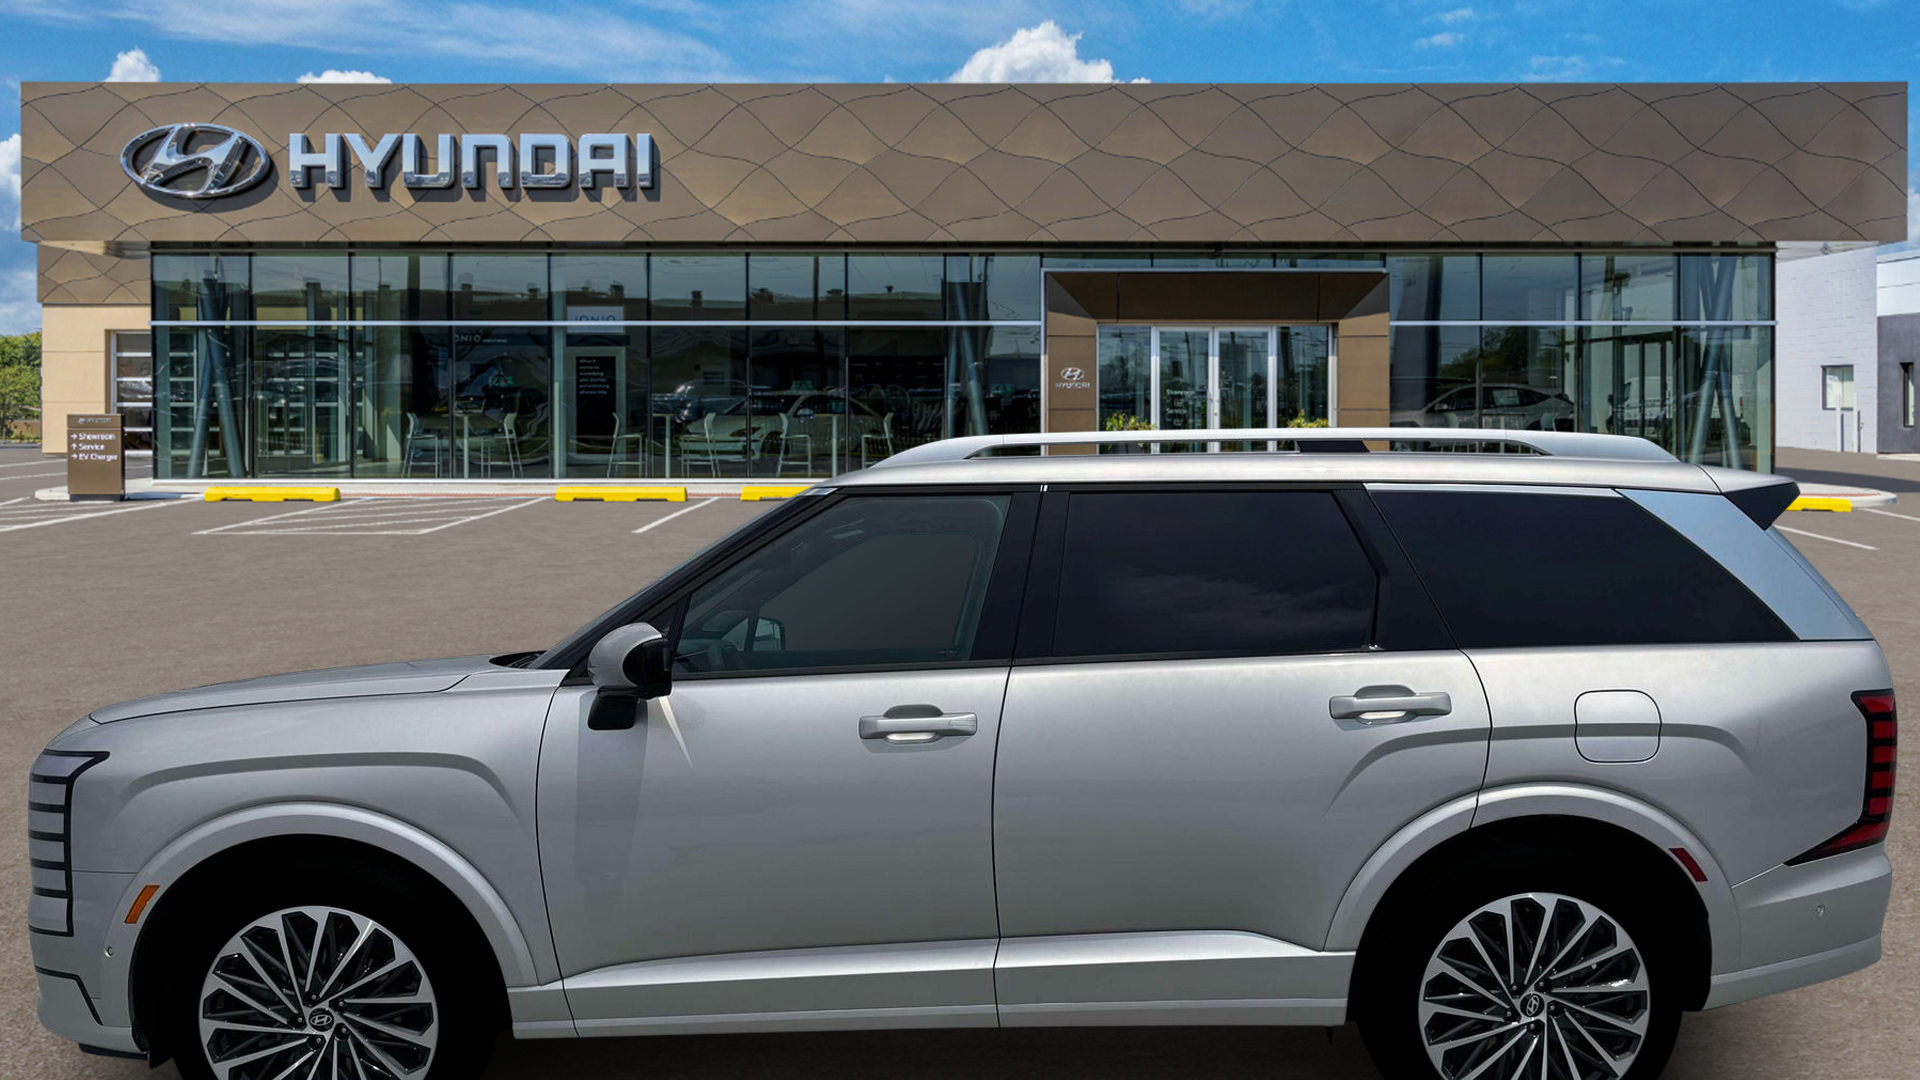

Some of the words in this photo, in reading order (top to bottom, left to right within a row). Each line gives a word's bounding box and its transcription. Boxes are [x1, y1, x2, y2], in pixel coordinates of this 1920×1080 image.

[289, 133, 654, 189] HYUNDAI
[78, 442, 105, 450] Service
[90, 453, 118, 462] Charger
